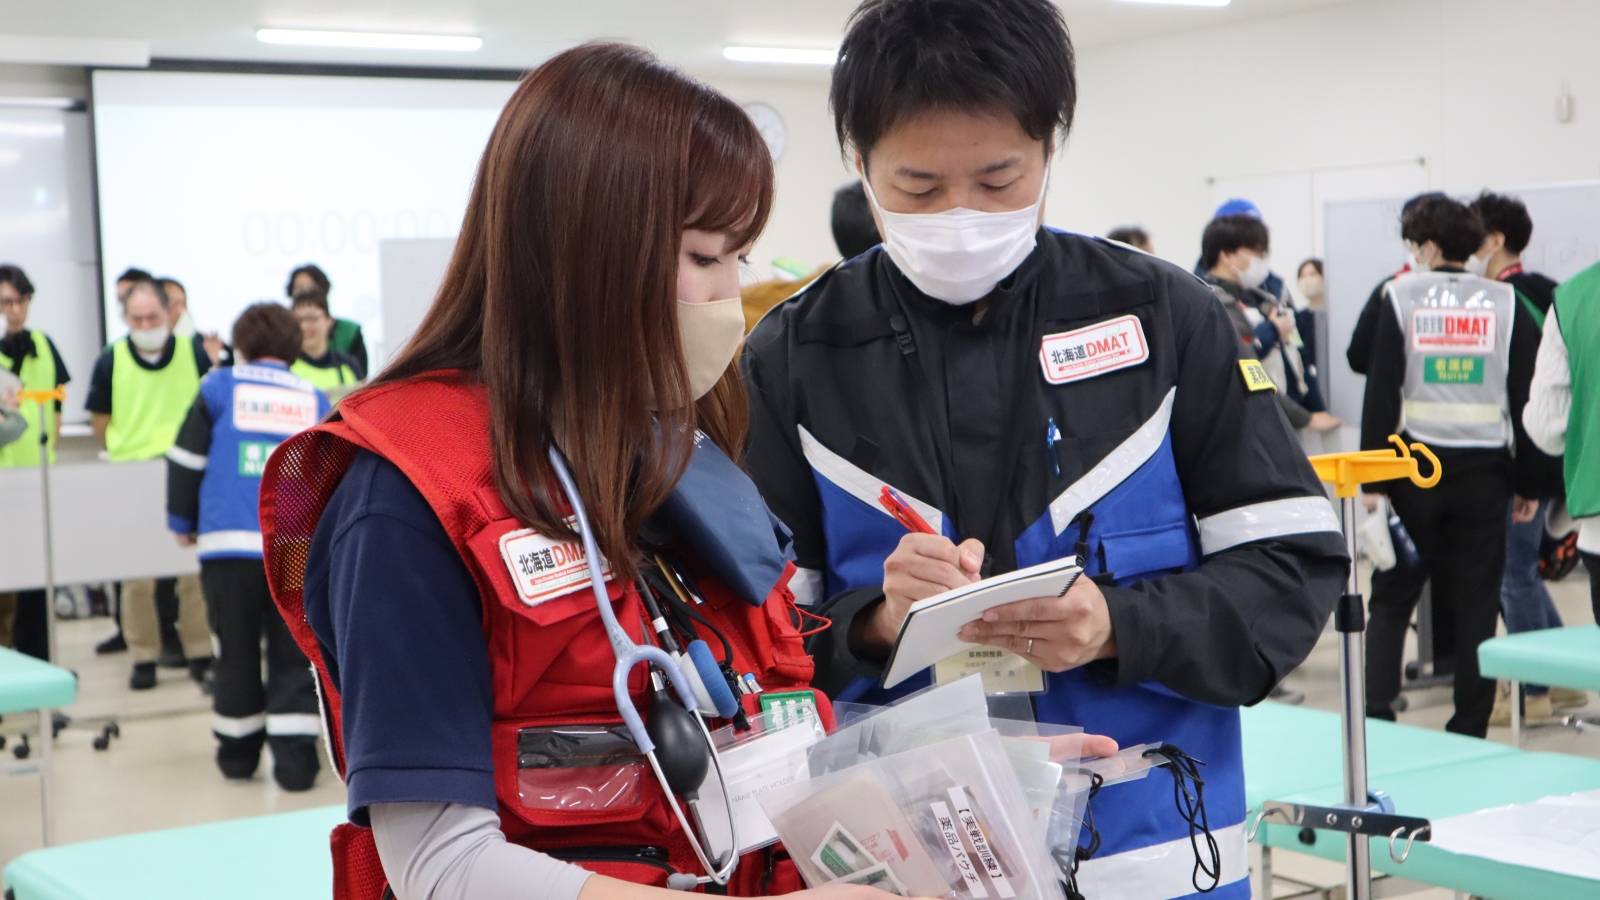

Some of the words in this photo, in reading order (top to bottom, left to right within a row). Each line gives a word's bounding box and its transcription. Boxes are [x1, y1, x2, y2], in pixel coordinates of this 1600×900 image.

[1051, 331, 1130, 365] 北海道DMAT
[731, 791, 752, 805] NAME
[752, 784, 770, 797] PLATE
[770, 775, 795, 790] HOLDER
[938, 816, 979, 884] 薬品パウチ
[958, 808, 1003, 879] 【実戦訓練】
